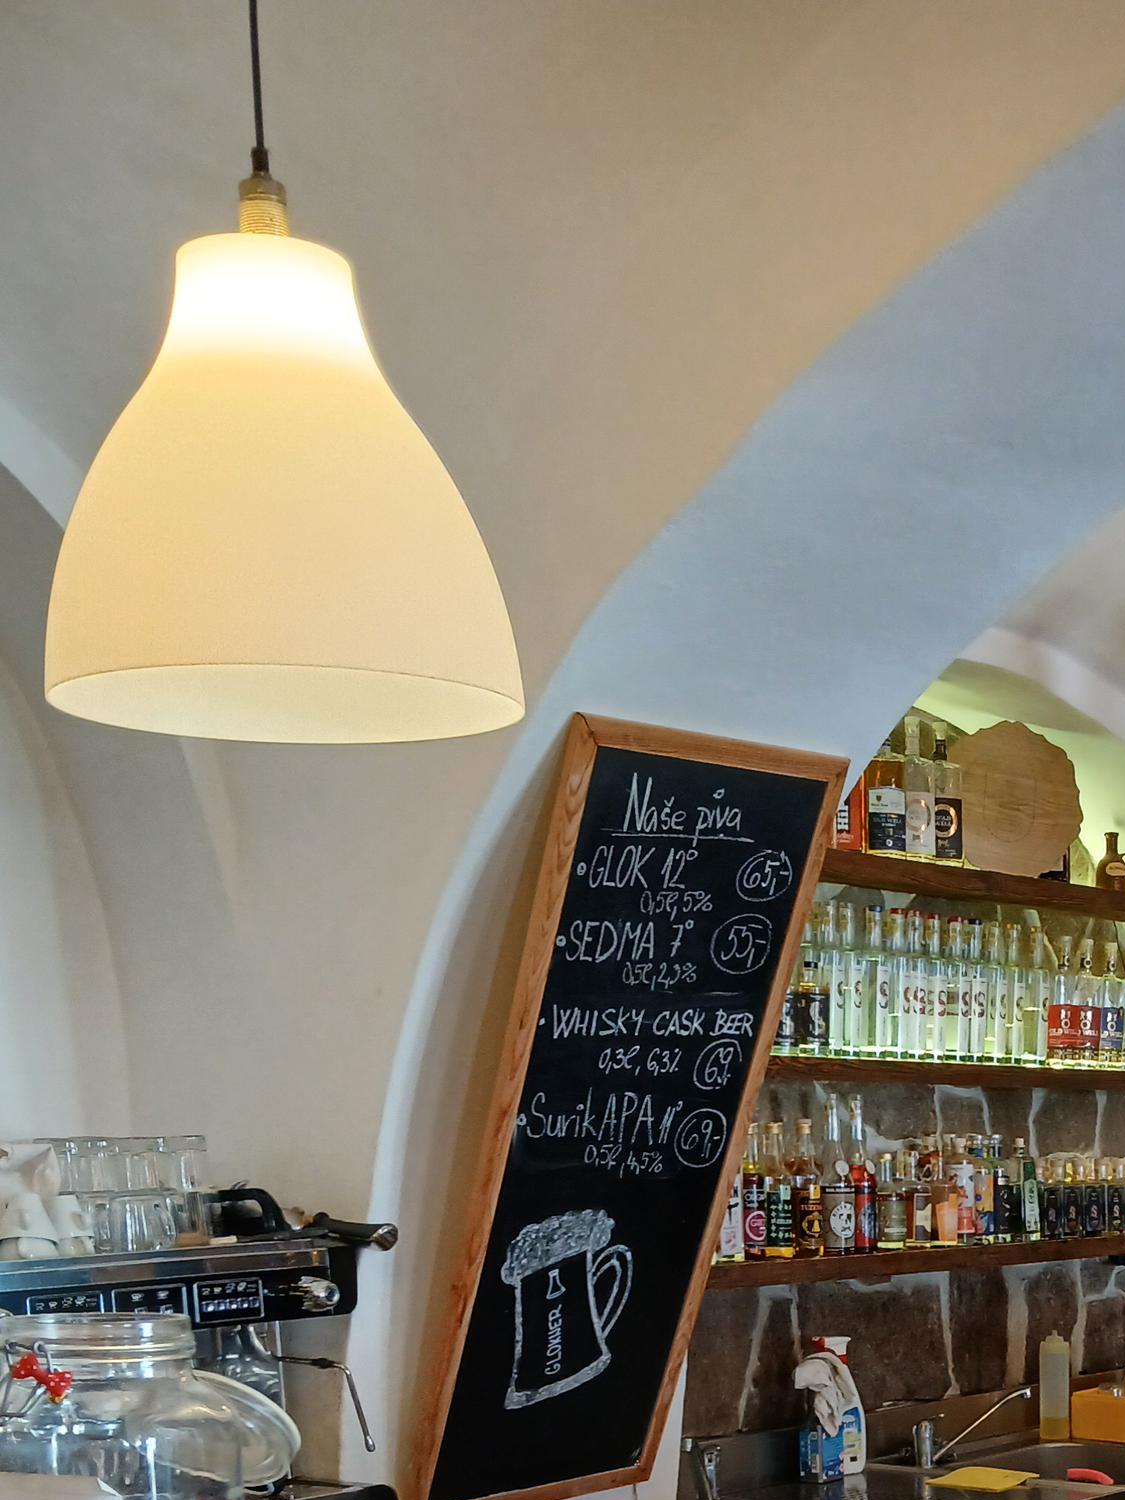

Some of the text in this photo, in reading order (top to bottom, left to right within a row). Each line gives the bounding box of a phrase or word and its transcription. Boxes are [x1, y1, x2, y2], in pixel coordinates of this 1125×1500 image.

[623, 772, 743, 847] Naše piva
[589, 845, 655, 889] GLOK
[565, 920, 655, 963] SEDMA
[552, 1004, 754, 1039] WHISKY CASK BEER
